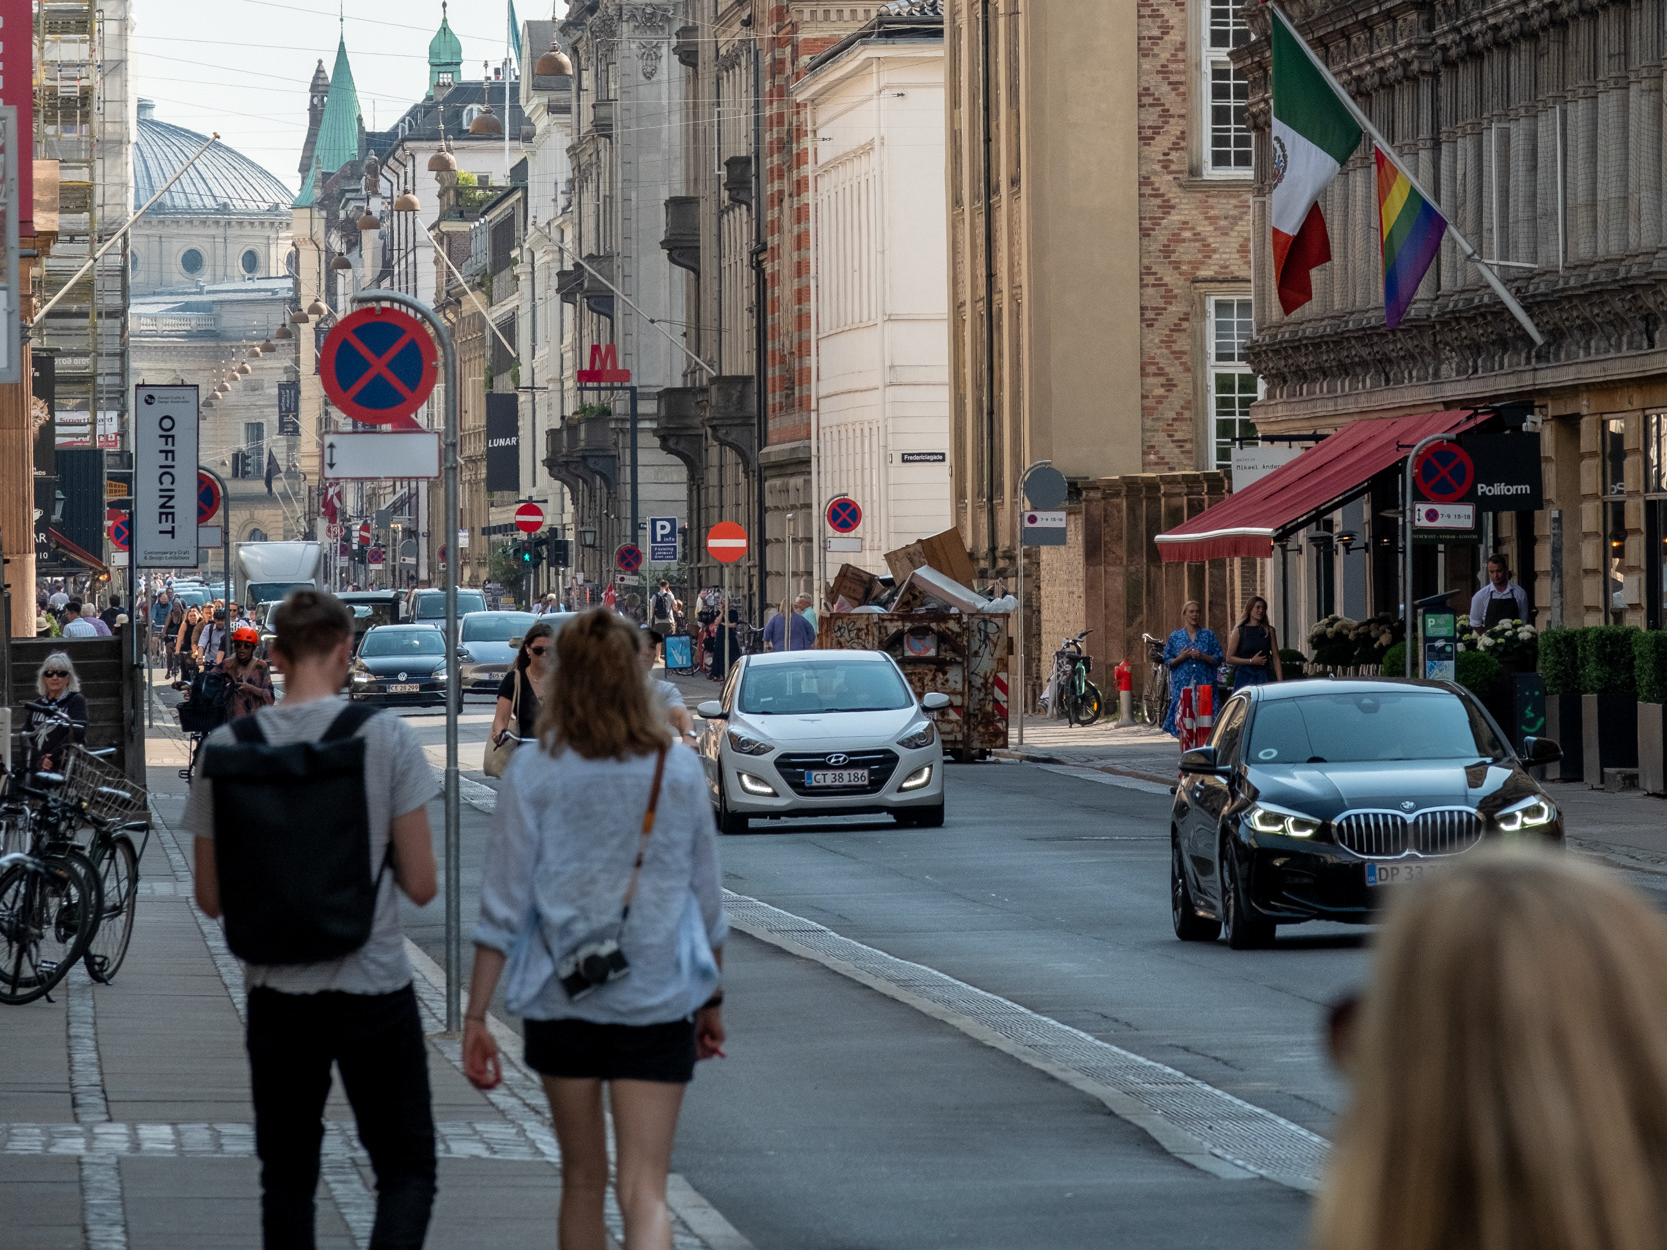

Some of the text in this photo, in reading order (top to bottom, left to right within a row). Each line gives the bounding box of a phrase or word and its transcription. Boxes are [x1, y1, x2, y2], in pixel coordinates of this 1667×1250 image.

[488, 437, 517, 448] LUNAR
[158, 415, 176, 540] OFFICINET
[1477, 482, 1531, 496] Poliform
[656, 520, 671, 542] P
[1428, 618, 1436, 627] P
[813, 772, 867, 783] CT 38 186
[1378, 866, 1400, 882] DP
